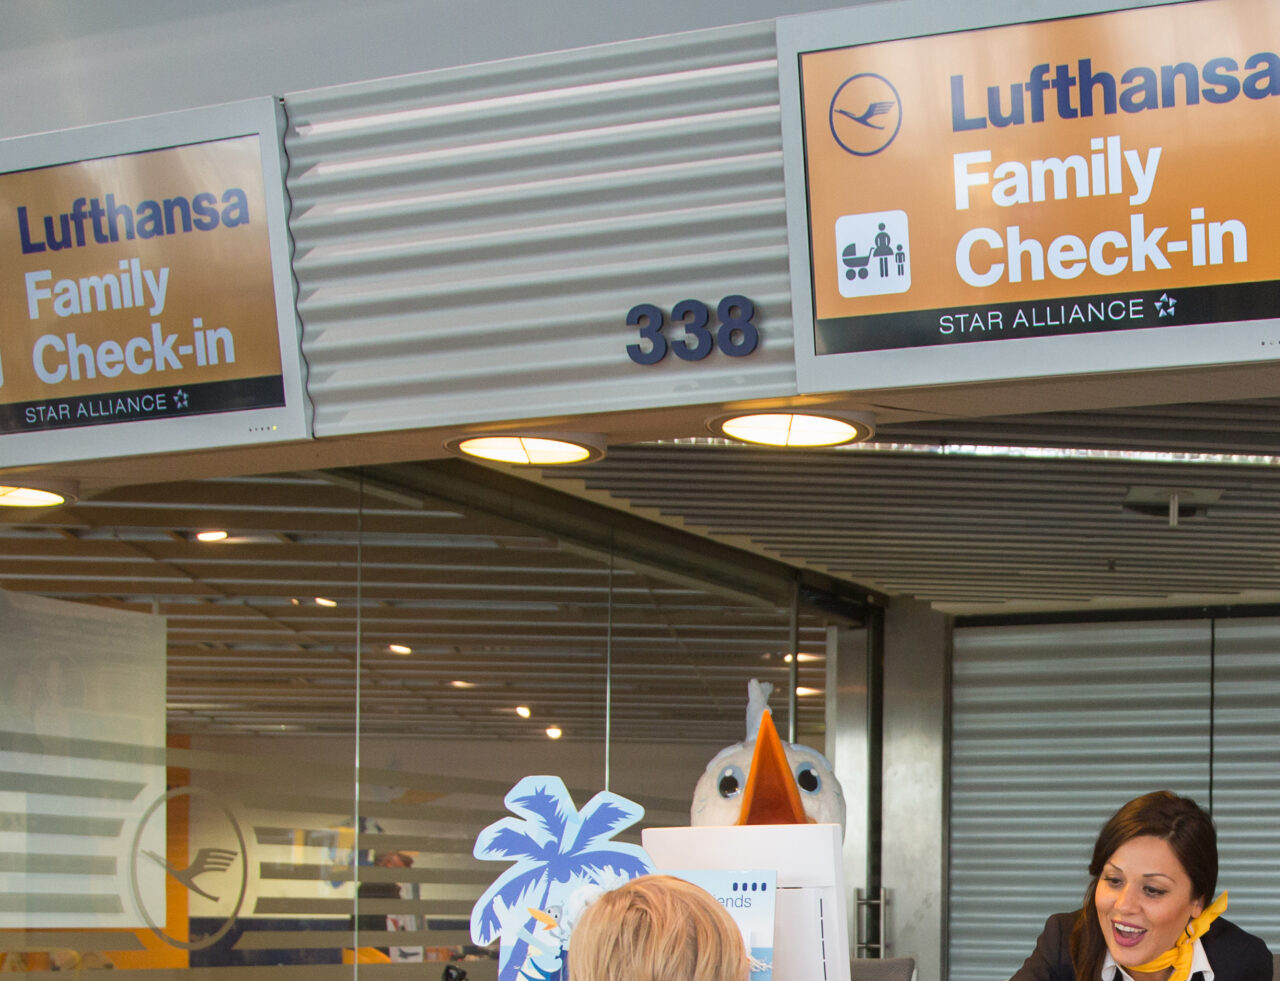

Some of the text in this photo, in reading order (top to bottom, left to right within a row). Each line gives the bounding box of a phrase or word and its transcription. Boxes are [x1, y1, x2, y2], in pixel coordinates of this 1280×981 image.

[953, 136, 1162, 210] Family
[17, 188, 250, 254] Lufthansa
[955, 208, 1248, 288] Check-in
[25, 258, 169, 320] Family
[939, 299, 1144, 334] STAR ALLIANCE
[32, 318, 235, 384] Check-in
[626, 295, 759, 365] 338
[25, 394, 167, 423] STAR ALLIANCE
[713, 894, 752, 908] ends
